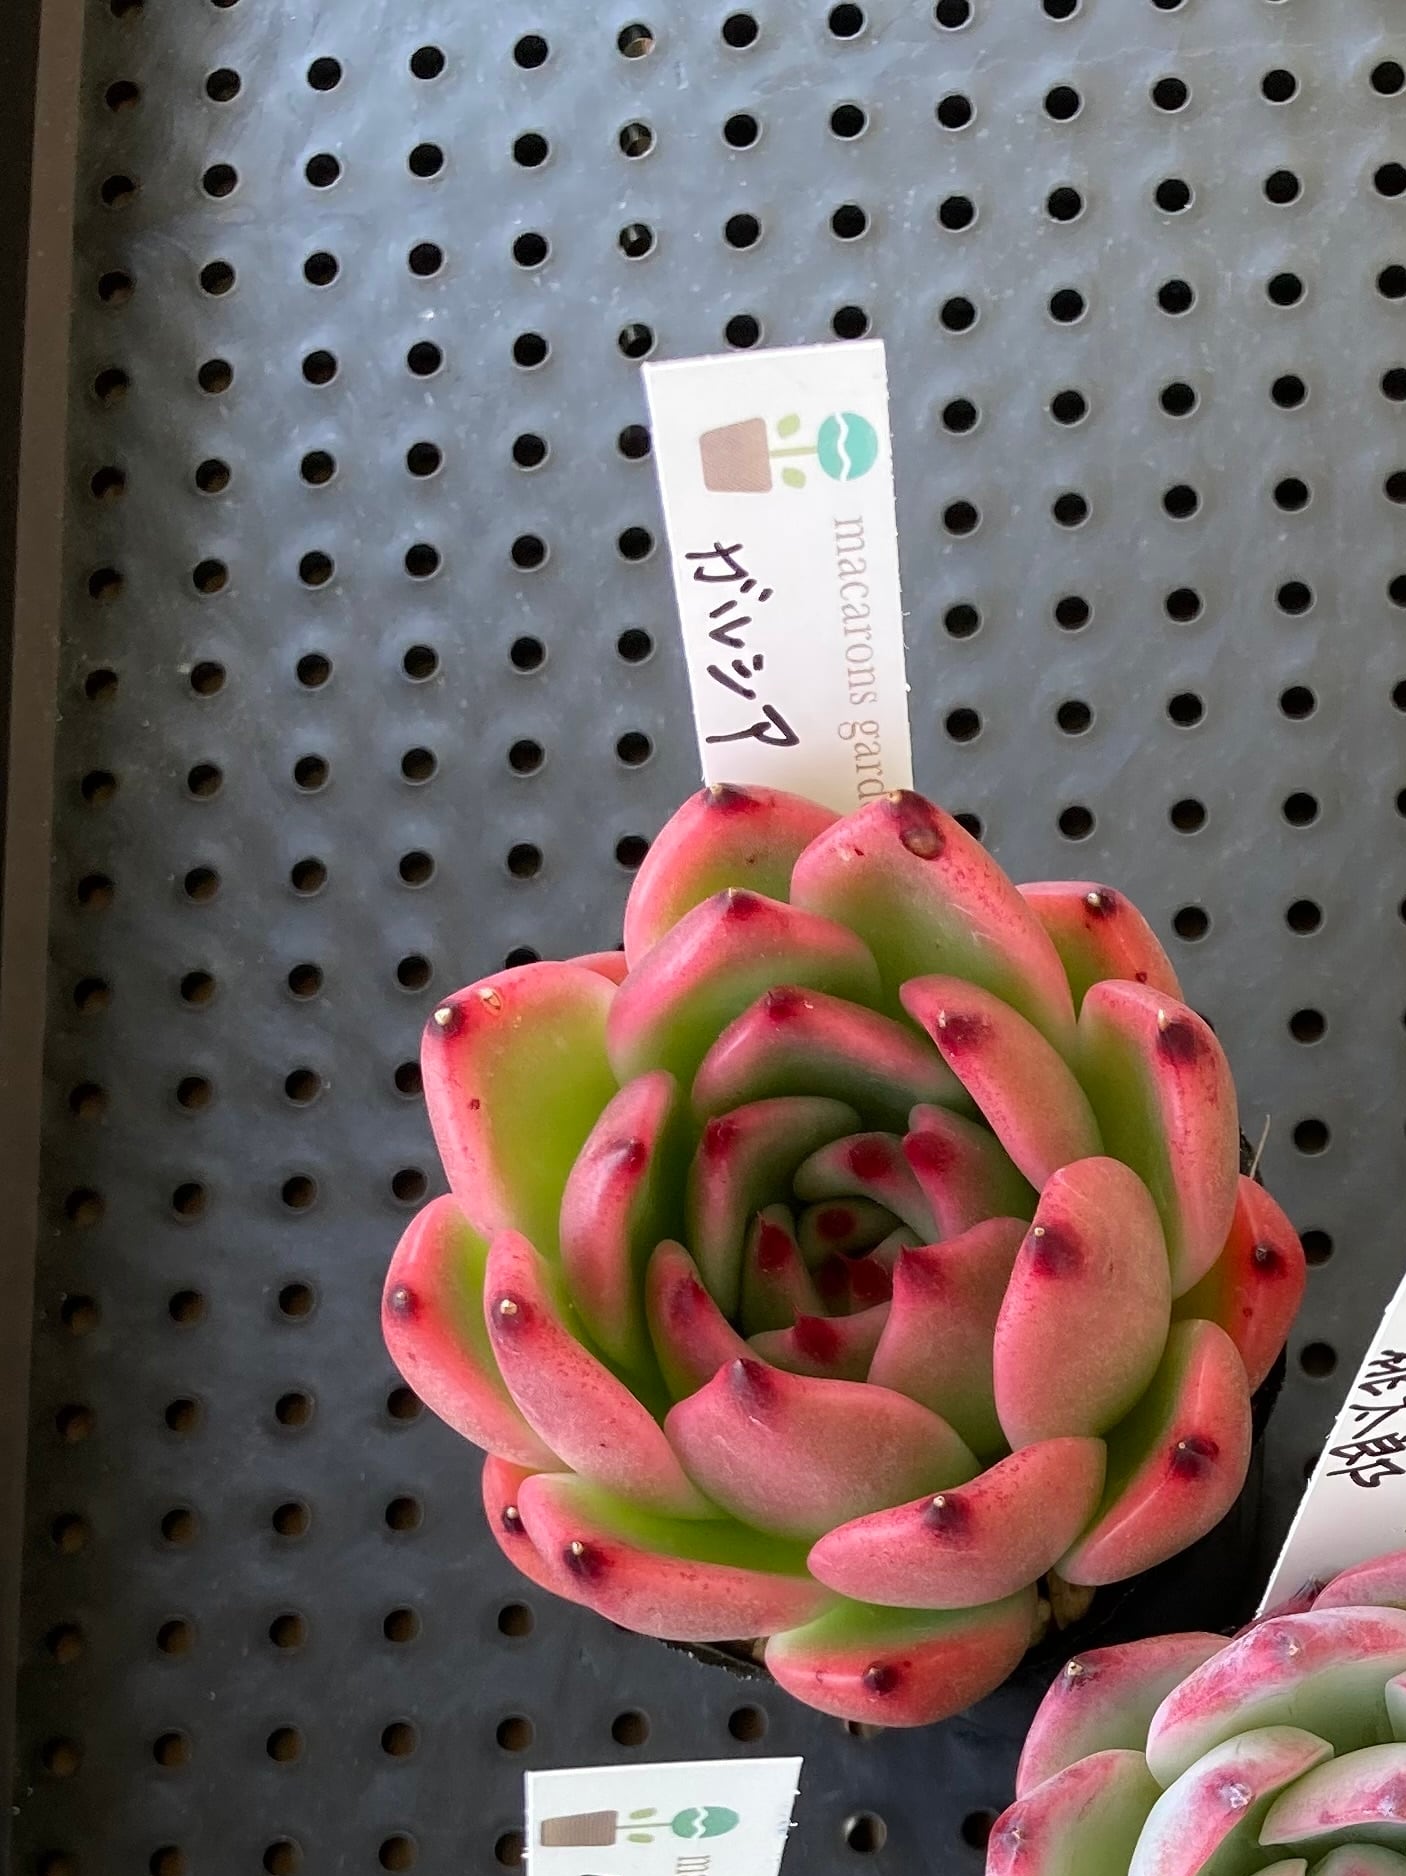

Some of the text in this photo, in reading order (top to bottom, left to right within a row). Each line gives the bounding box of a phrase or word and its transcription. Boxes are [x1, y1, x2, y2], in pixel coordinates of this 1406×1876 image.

[685, 542, 800, 747] ガルシア
[833, 515, 889, 801] macarons gard
